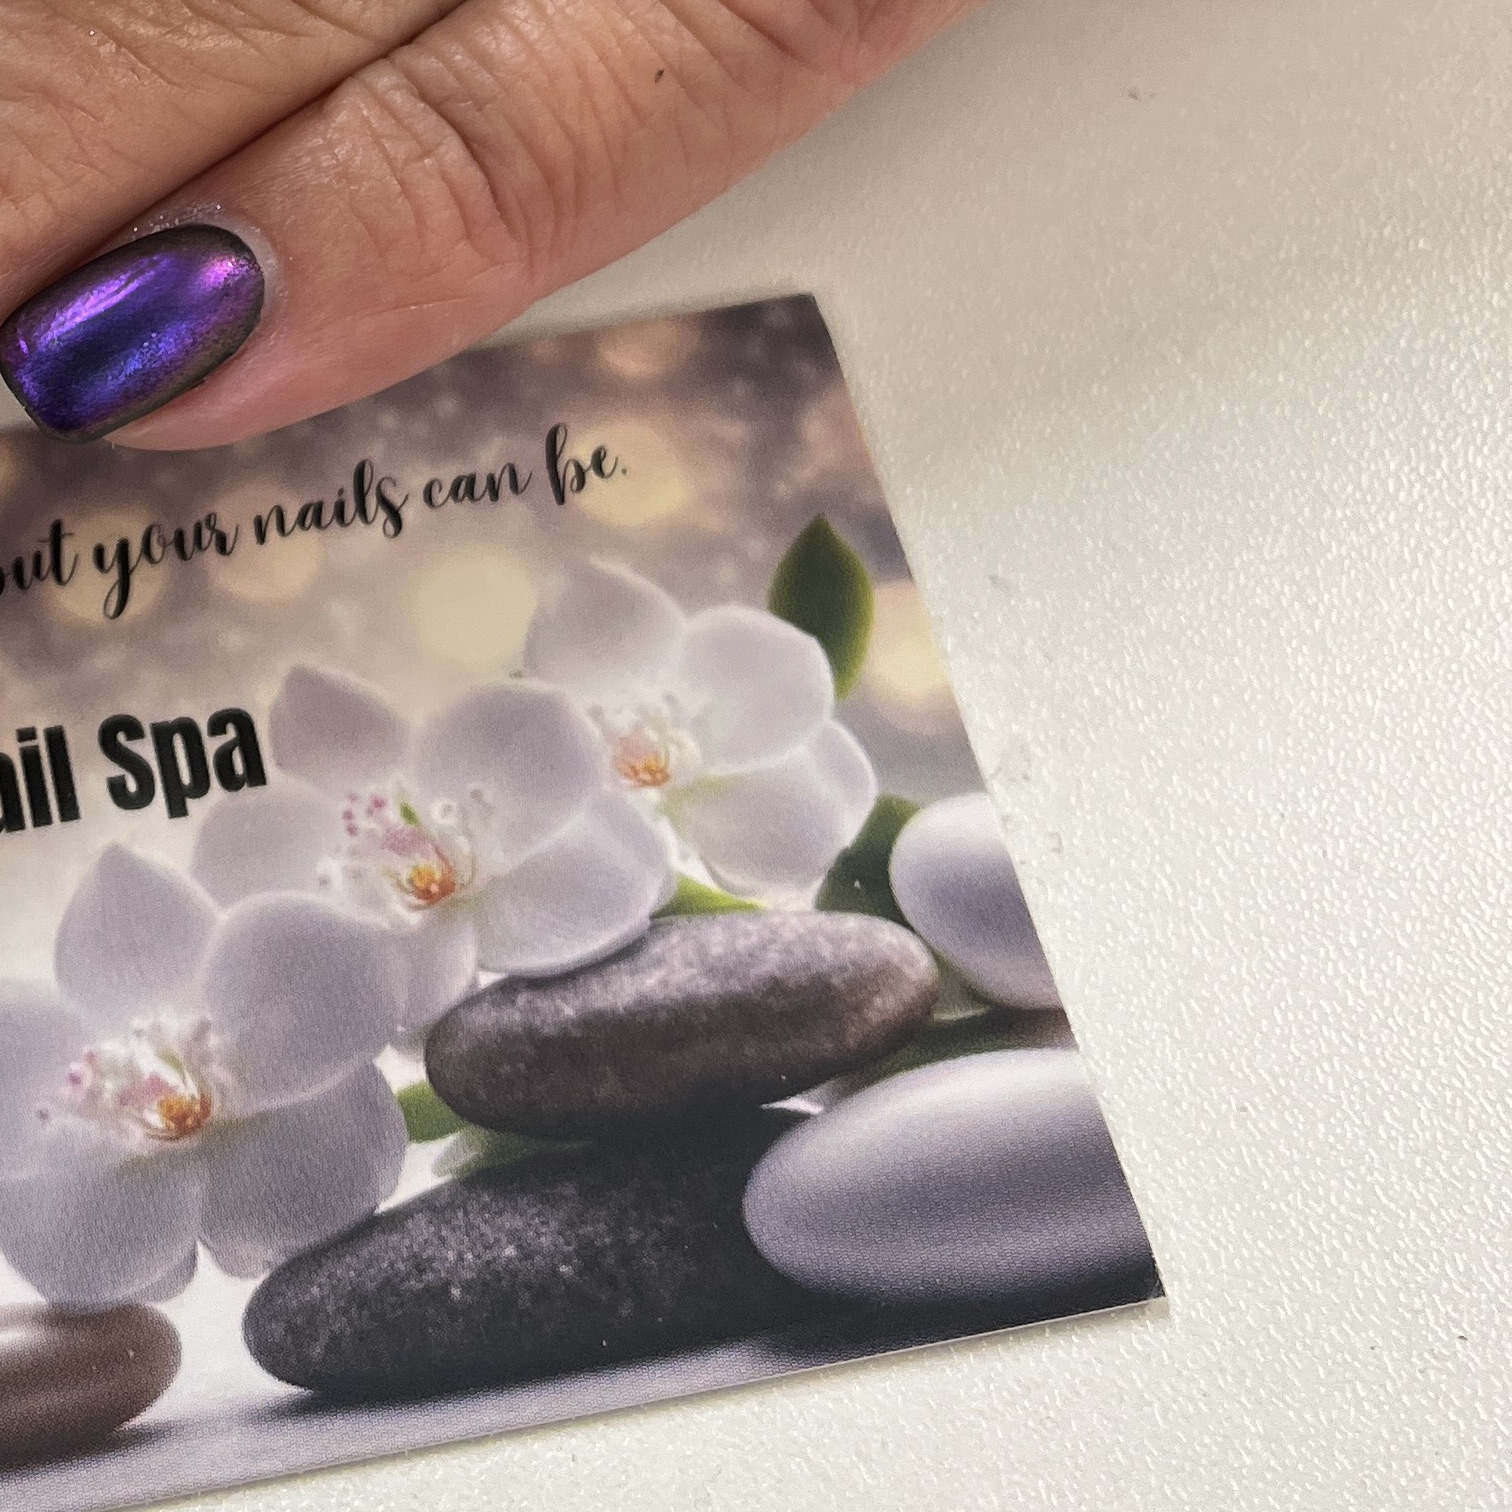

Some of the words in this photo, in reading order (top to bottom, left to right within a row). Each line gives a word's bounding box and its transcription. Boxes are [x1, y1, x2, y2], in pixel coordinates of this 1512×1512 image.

[92, 511, 240, 620] your
[253, 458, 409, 539] nails
[423, 460, 532, 509] can
[545, 422, 628, 506] be.
[97, 707, 268, 819] Spa
